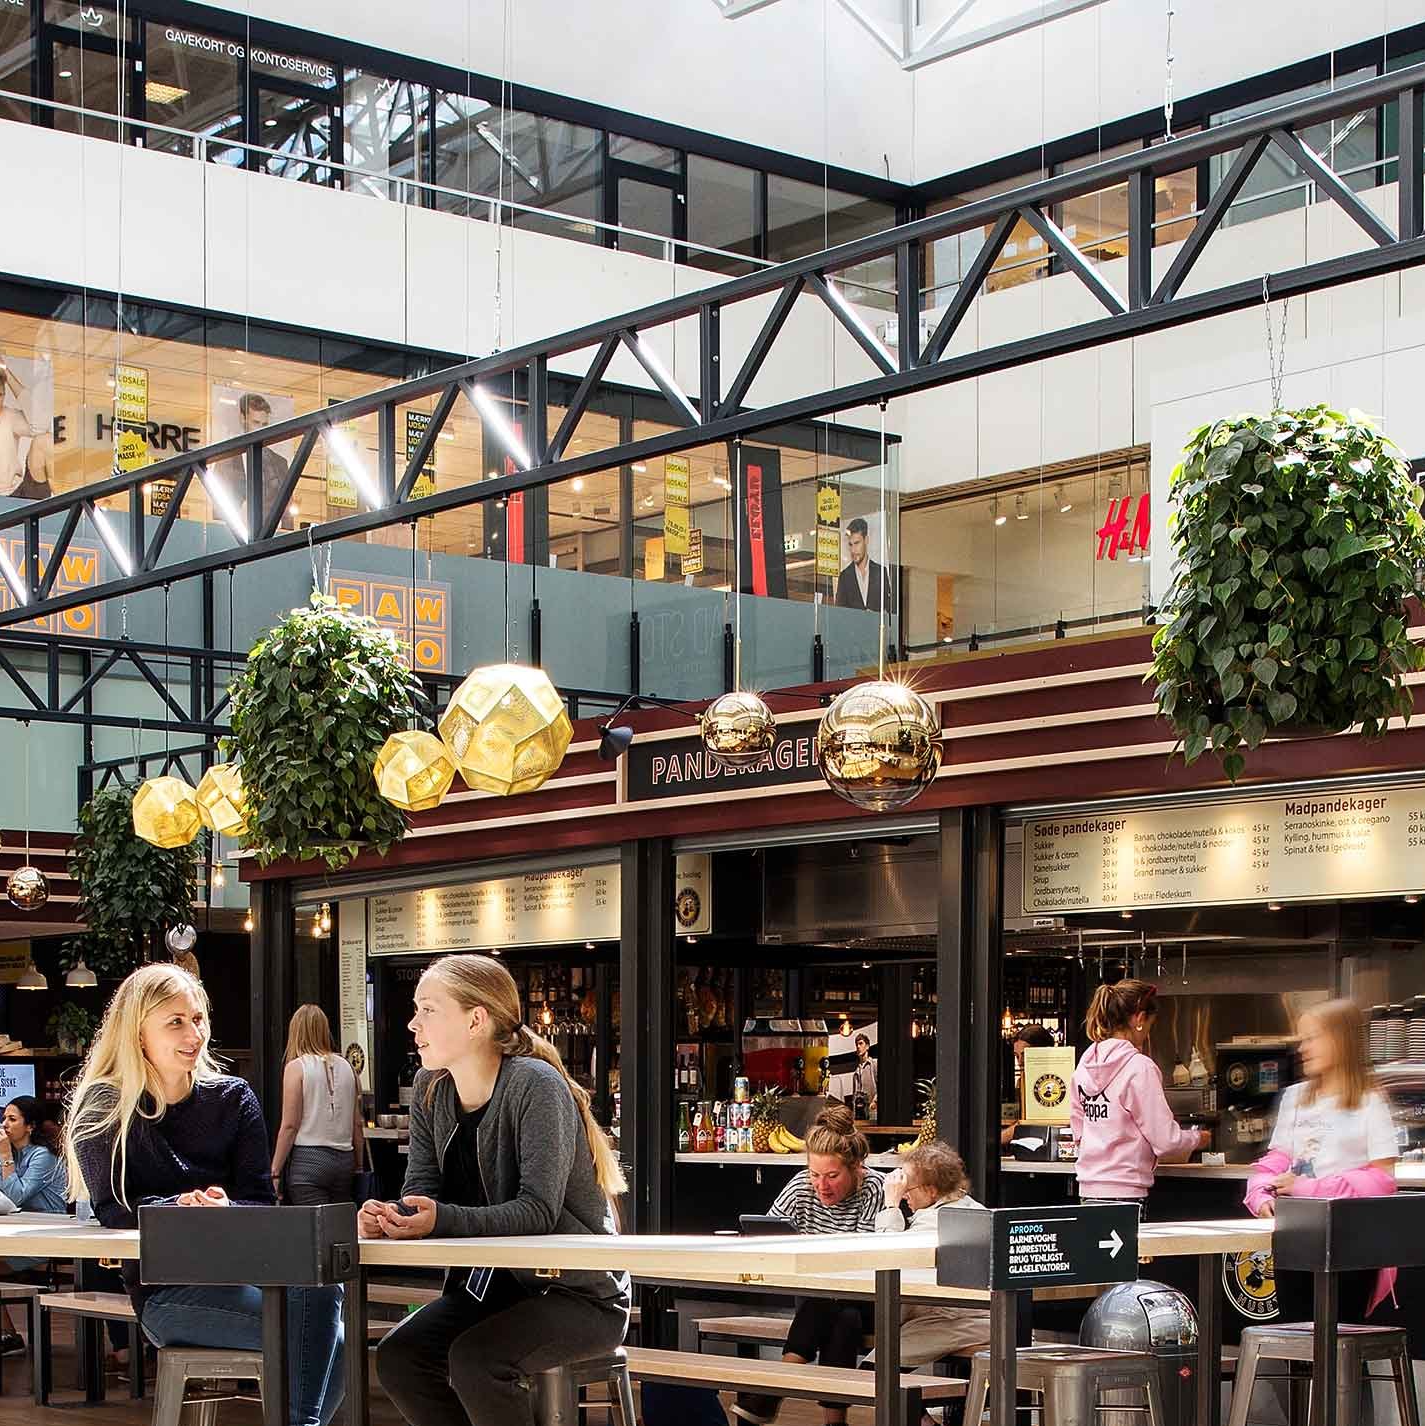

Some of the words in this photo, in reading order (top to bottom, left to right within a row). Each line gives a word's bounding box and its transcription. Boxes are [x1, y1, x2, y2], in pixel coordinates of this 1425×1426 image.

[165, 29, 223, 54] GAVEKORT
[227, 45, 245, 58] OG
[251, 52, 334, 79] KONTOSERVICE
[97, 414, 201, 452] HRRE
[337, 589, 442, 622] PAW
[1285, 797, 1388, 817] Madpandekager
[1285, 818, 1337, 831] Serranoskinke,
[1358, 814, 1390, 825] oregano
[1408, 812, 1418, 820] 55
[1034, 823, 1061, 838] Søde
[1063, 819, 1127, 838] pandekager
[1157, 827, 1217, 842] chokolade/nutella
[1252, 824, 1261, 833] 45
[1284, 833, 1311, 843] Kylling,
[1312, 829, 1344, 841] hummus
[1408, 825, 1418, 833] 60
[1034, 841, 1055, 850] Sukker
[1142, 840, 1202, 854] chokolade/nutella
[1252, 837, 1261, 845] 45
[1284, 845, 1307, 856] Spinat
[1315, 842, 1329, 852] feta
[1408, 838, 1418, 846] 55
[1033, 853, 1056, 862] Sukker
[1061, 850, 1079, 859] citron
[1146, 853, 1196, 865] jordbærsyltetøj
[1252, 849, 1261, 857] 45
[1033, 863, 1070, 873] Kanelsukker
[1134, 868, 1154, 877] Grand
[1155, 866, 1177, 876] manier
[1185, 865, 1207, 874] sukker
[1033, 876, 1049, 886] Sirup
[1034, 886, 1081, 897] Jordbærsyltetøj
[1156, 889, 1192, 899] Flødeskum
[1033, 895, 1089, 907] Chokolade/nutella
[1010, 1225, 1044, 1234] APROPOS
[1009, 1233, 1057, 1244] BARNEVOGNE
[1009, 1255, 1029, 1264] BRUG
[1030, 1253, 1064, 1263] VENLIGST
[1009, 1262, 1070, 1274] GLASELEVATOREN
